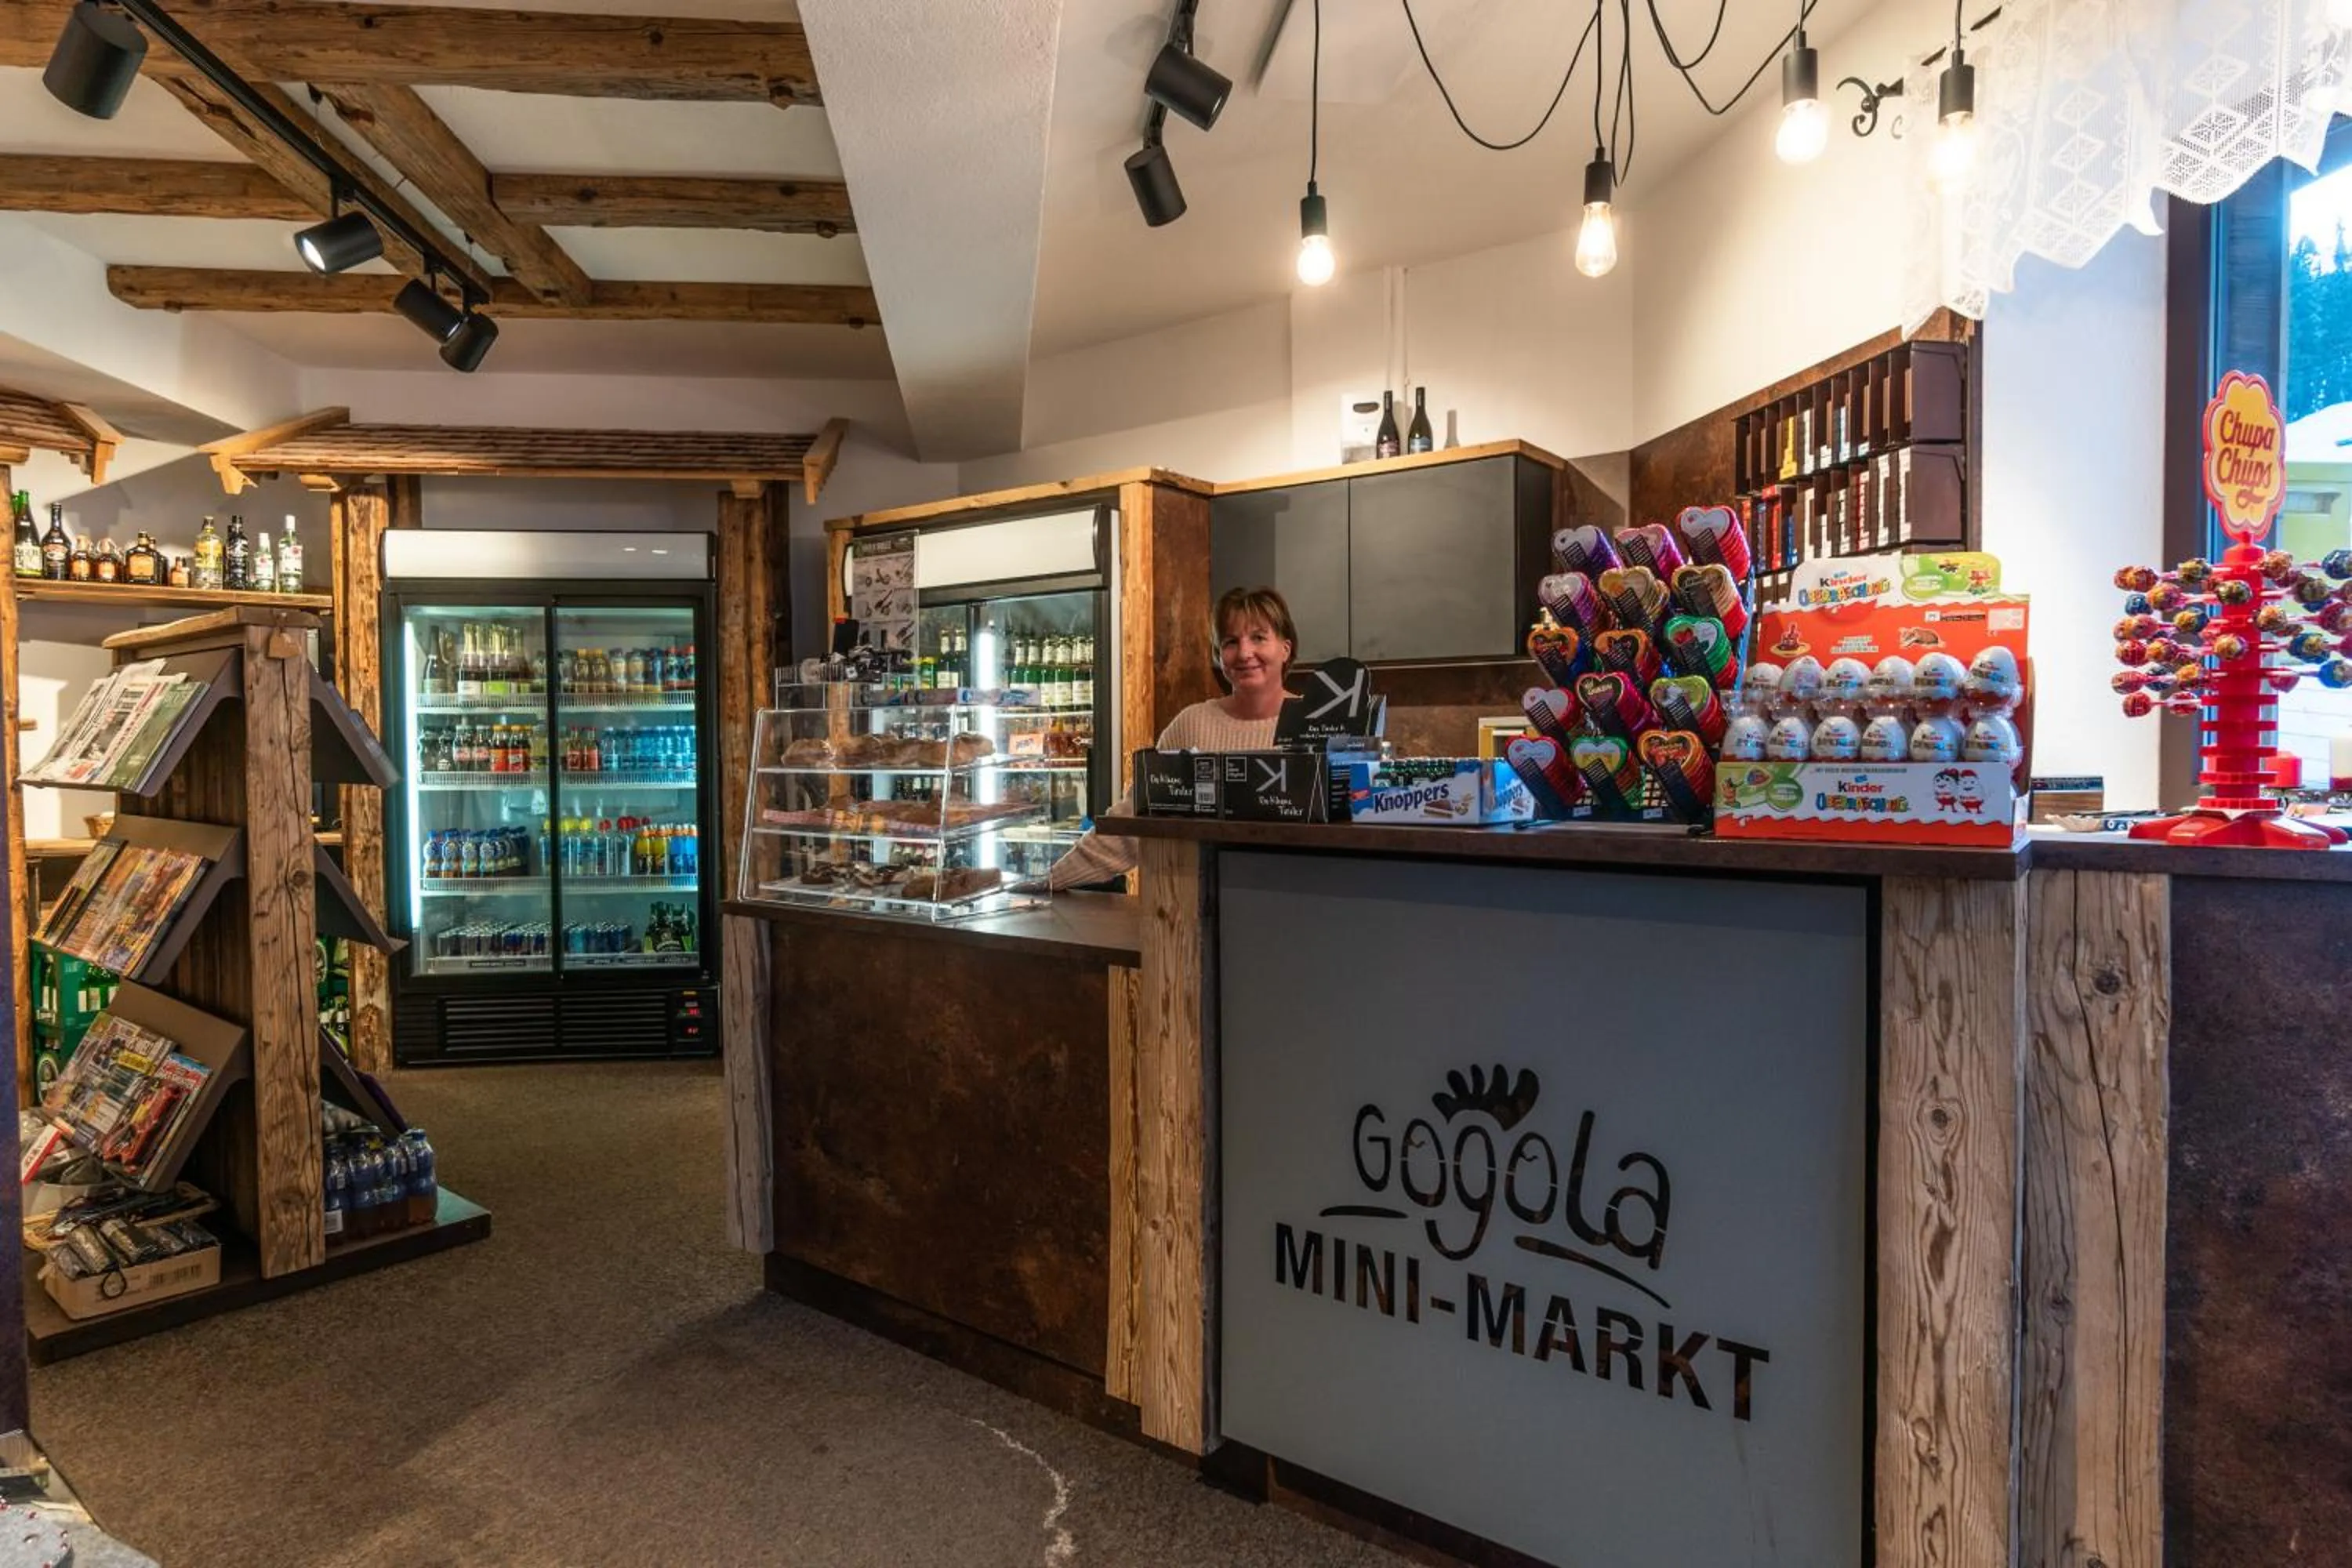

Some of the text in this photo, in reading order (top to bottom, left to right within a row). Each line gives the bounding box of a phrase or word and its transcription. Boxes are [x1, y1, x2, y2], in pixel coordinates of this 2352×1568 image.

[2220, 410, 2275, 457] Chupa
[2217, 447, 2272, 508] Chups
[1373, 784, 1449, 813] Knoppers
[1838, 780, 1886, 793] Kinder
[1352, 1102, 1671, 1270] Gogola
[1276, 1222, 1770, 1421] MINI-MARKT
